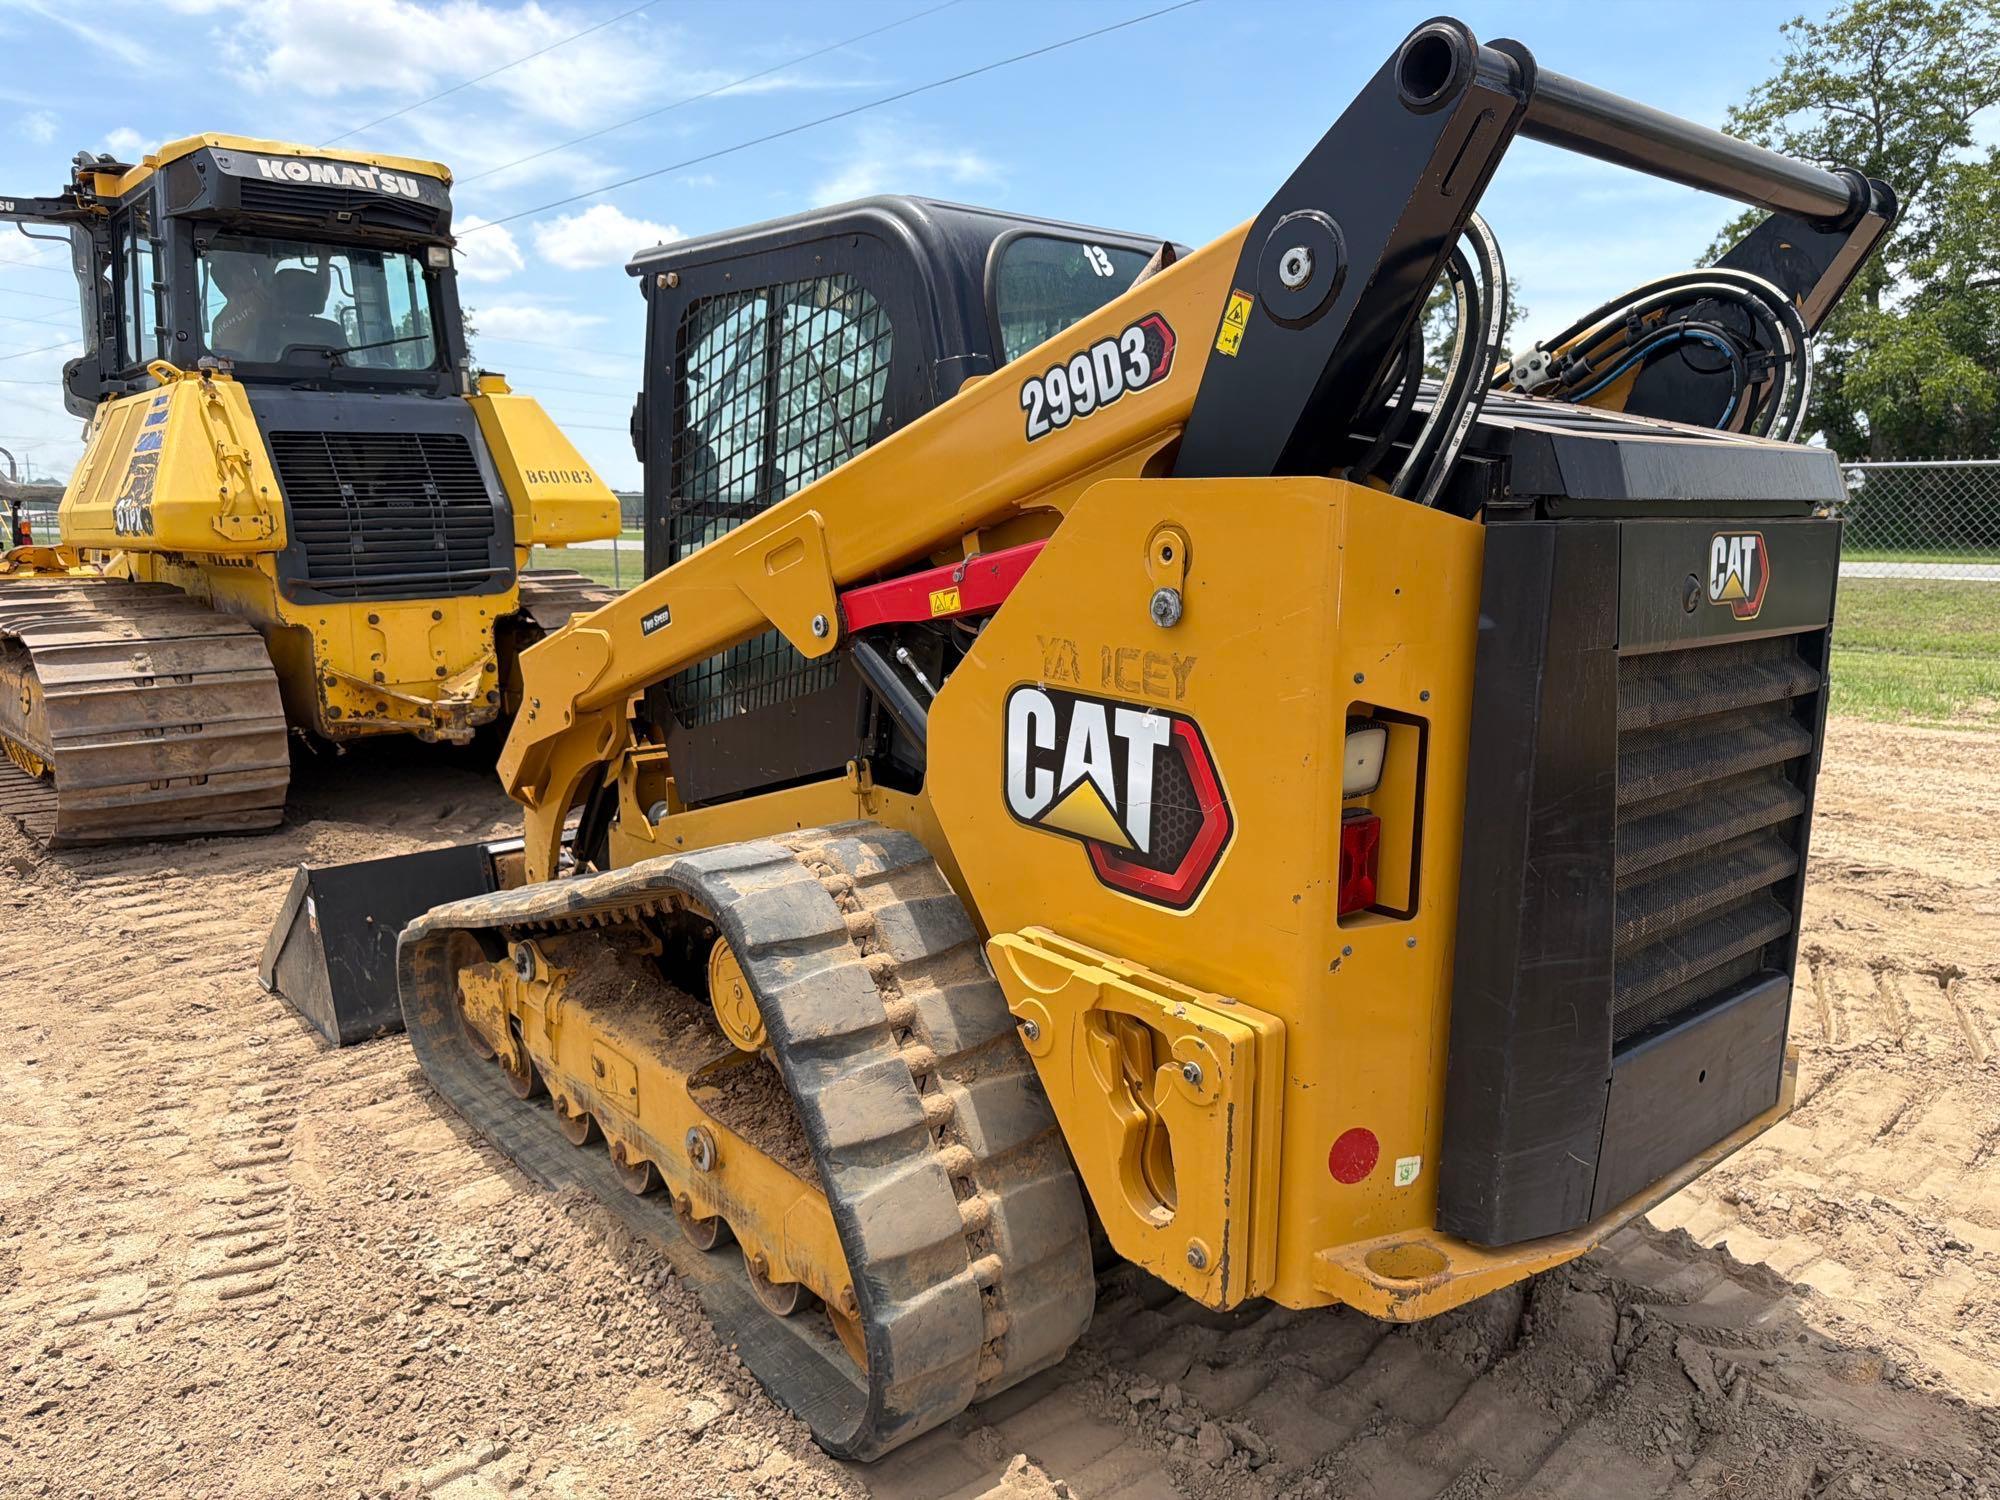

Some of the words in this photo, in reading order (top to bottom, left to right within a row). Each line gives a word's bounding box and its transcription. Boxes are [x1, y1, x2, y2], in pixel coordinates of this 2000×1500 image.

[256, 158, 420, 199] KOMATSU
[1083, 244, 1115, 277] 13
[1022, 326, 1151, 438] 299D3
[525, 469, 593, 484] B60083
[1709, 536, 1756, 600] CAT
[1007, 688, 1171, 855] CAT
